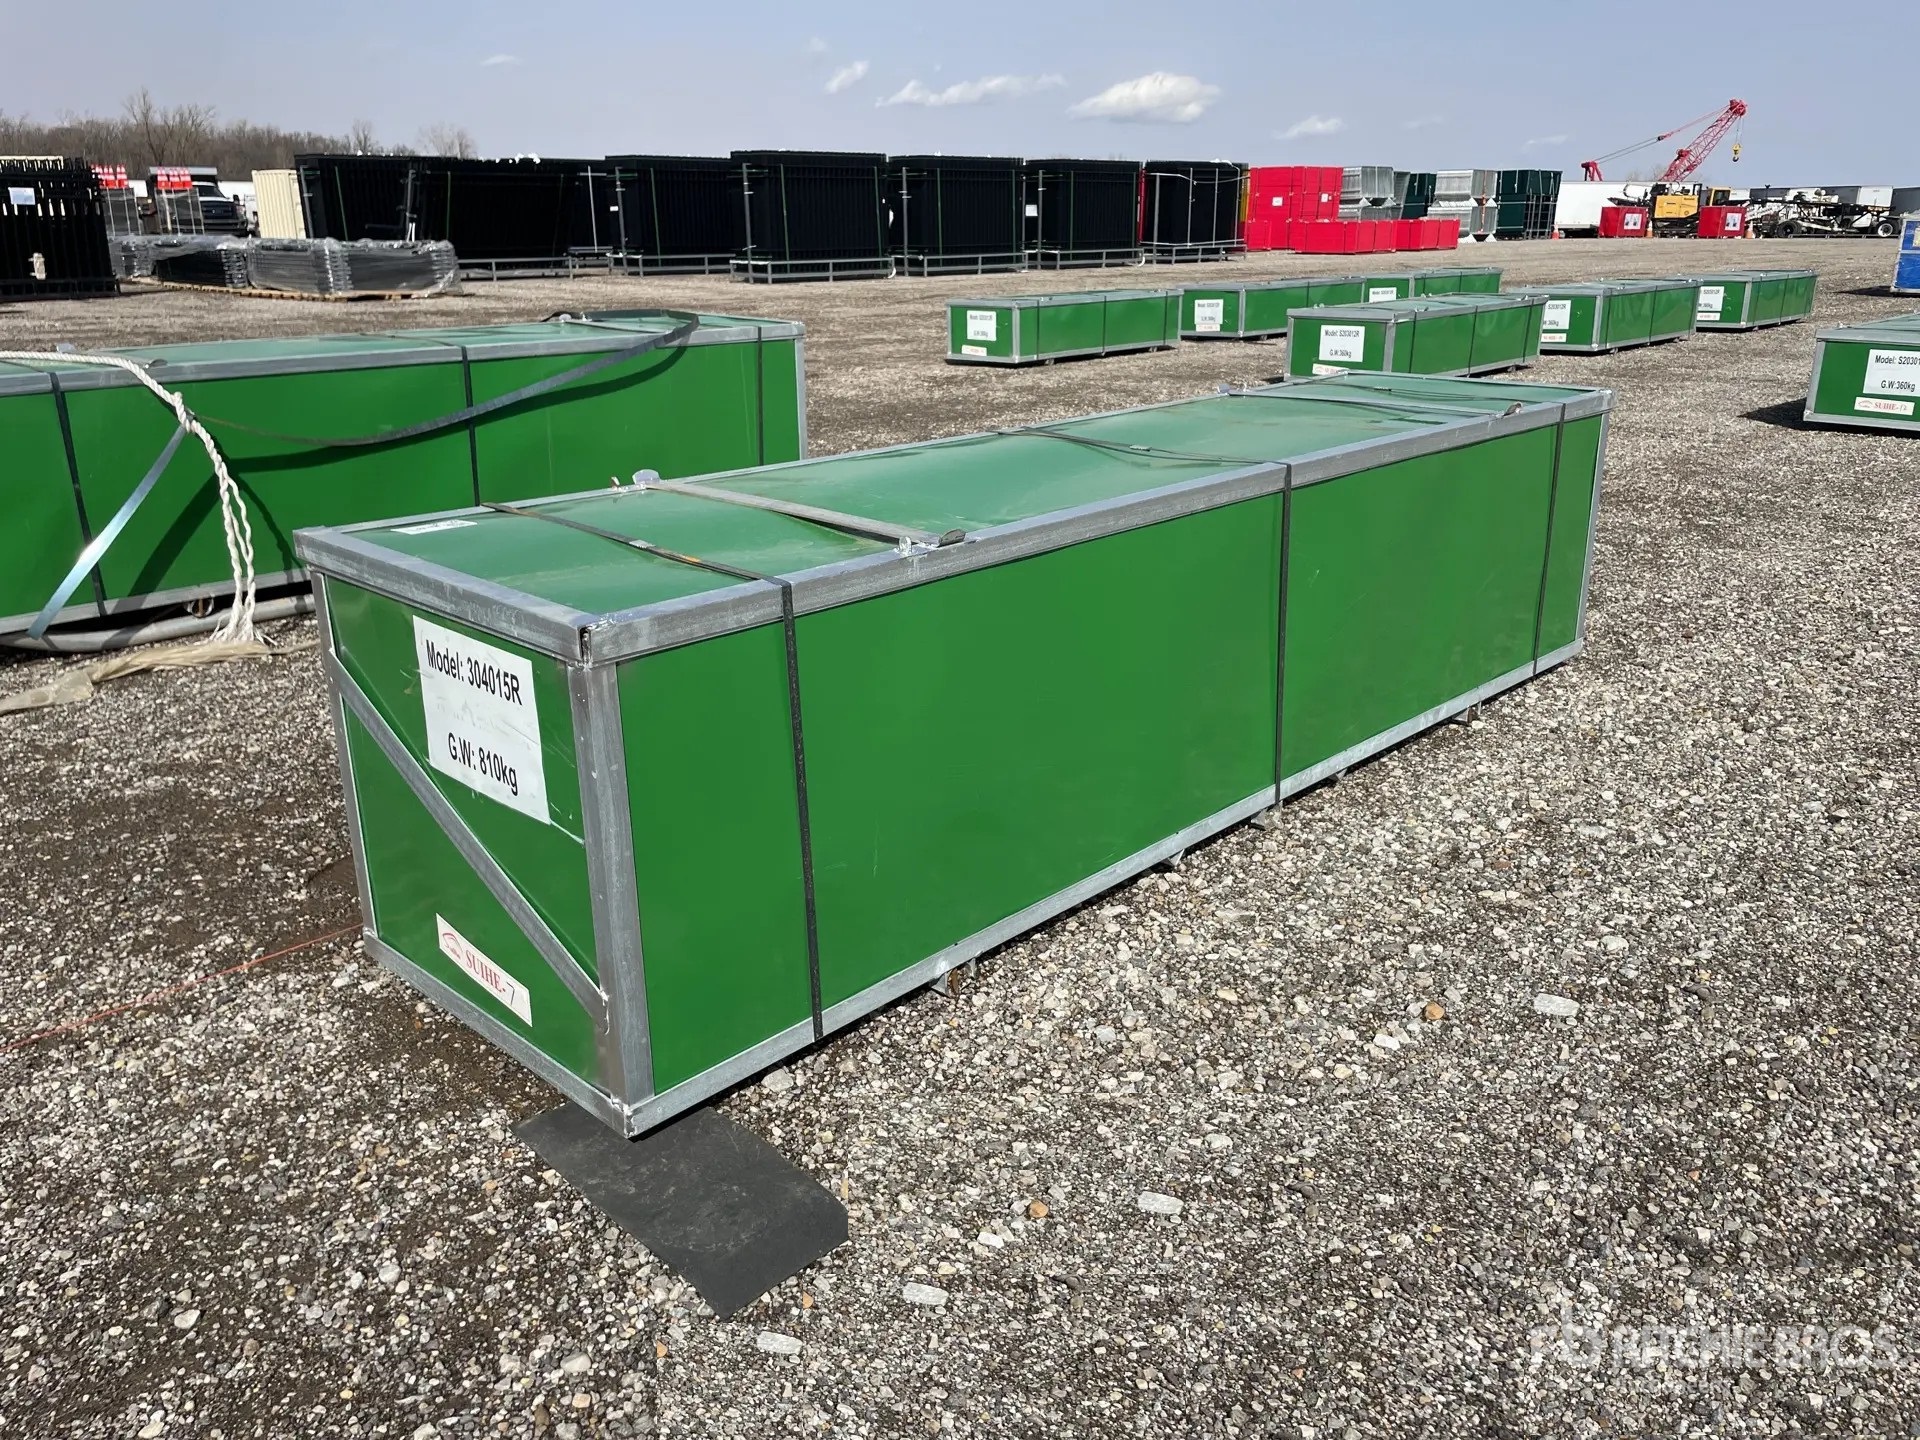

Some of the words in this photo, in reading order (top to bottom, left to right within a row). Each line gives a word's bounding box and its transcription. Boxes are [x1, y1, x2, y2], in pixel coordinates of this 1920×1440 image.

[1875, 355, 1897, 364] Model:
[426, 639, 465, 682] Model:
[466, 656, 523, 706] 304015R
[447, 732, 477, 772] G.W:
[477, 746, 519, 797] 810kg
